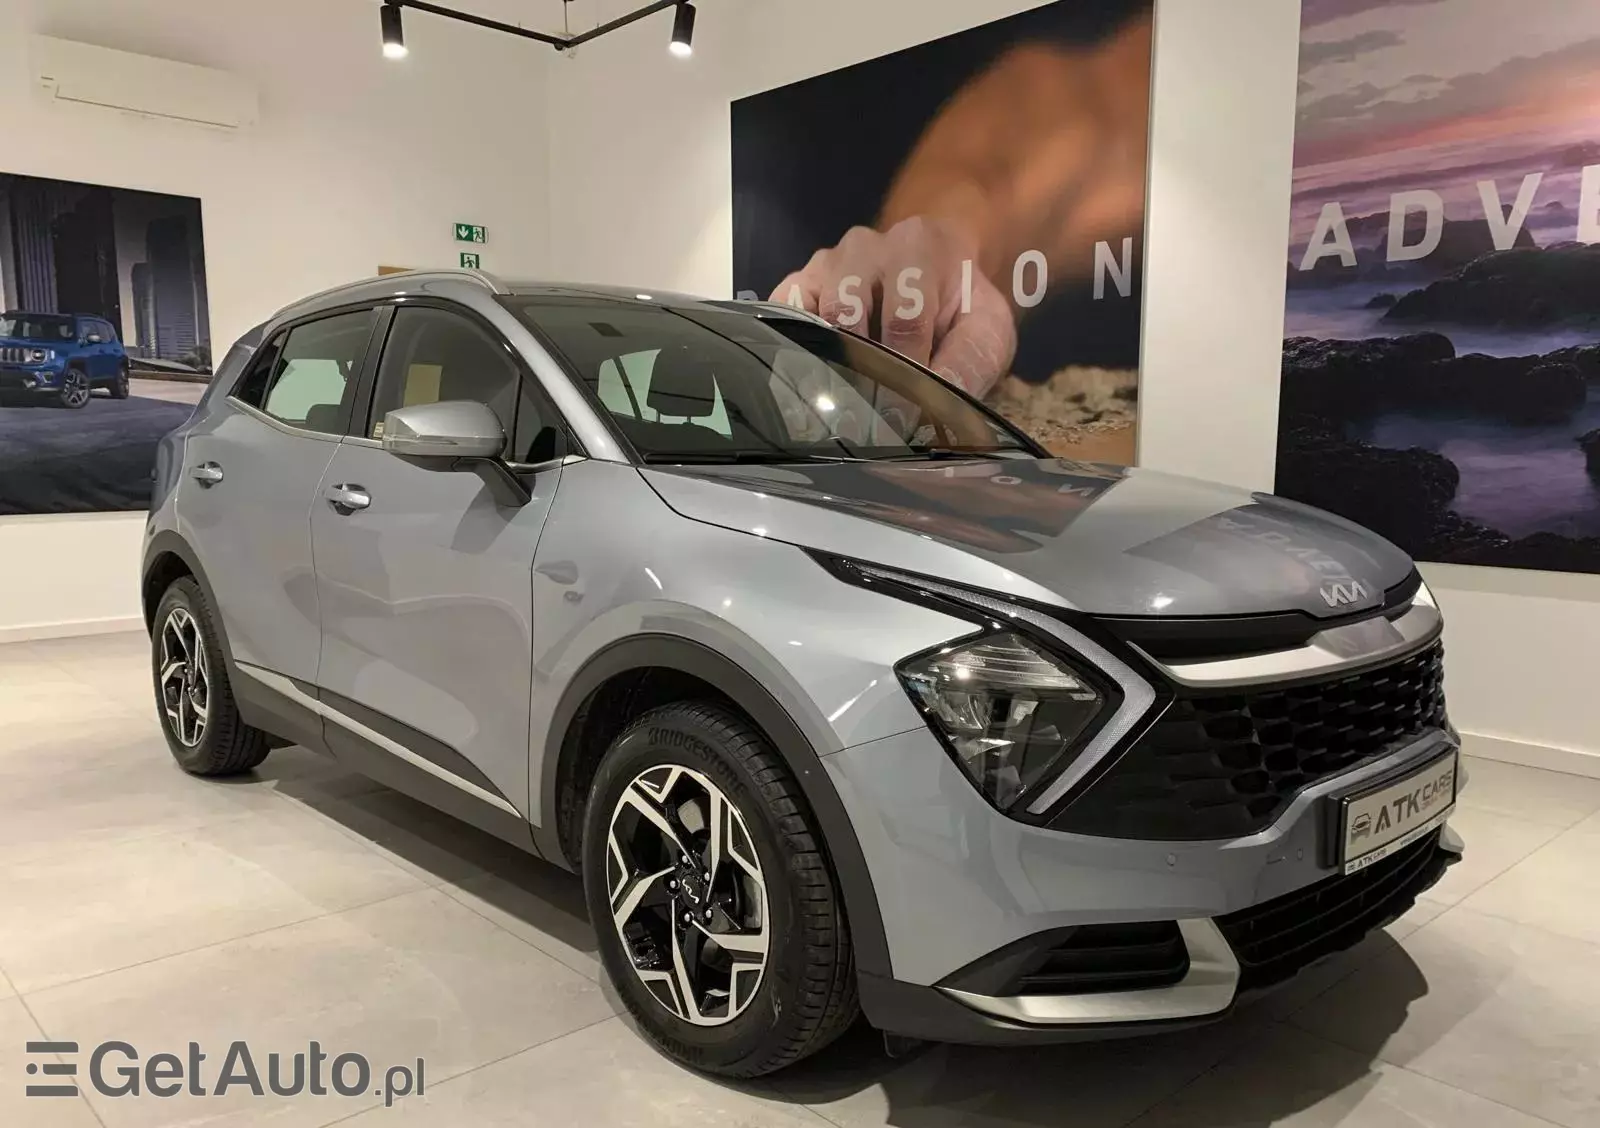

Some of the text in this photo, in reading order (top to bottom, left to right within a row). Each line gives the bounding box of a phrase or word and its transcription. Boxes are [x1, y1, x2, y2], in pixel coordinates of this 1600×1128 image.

[737, 237, 1133, 326] SSION
[1374, 789, 1421, 834] ATK
[1422, 769, 1452, 801] CARS
